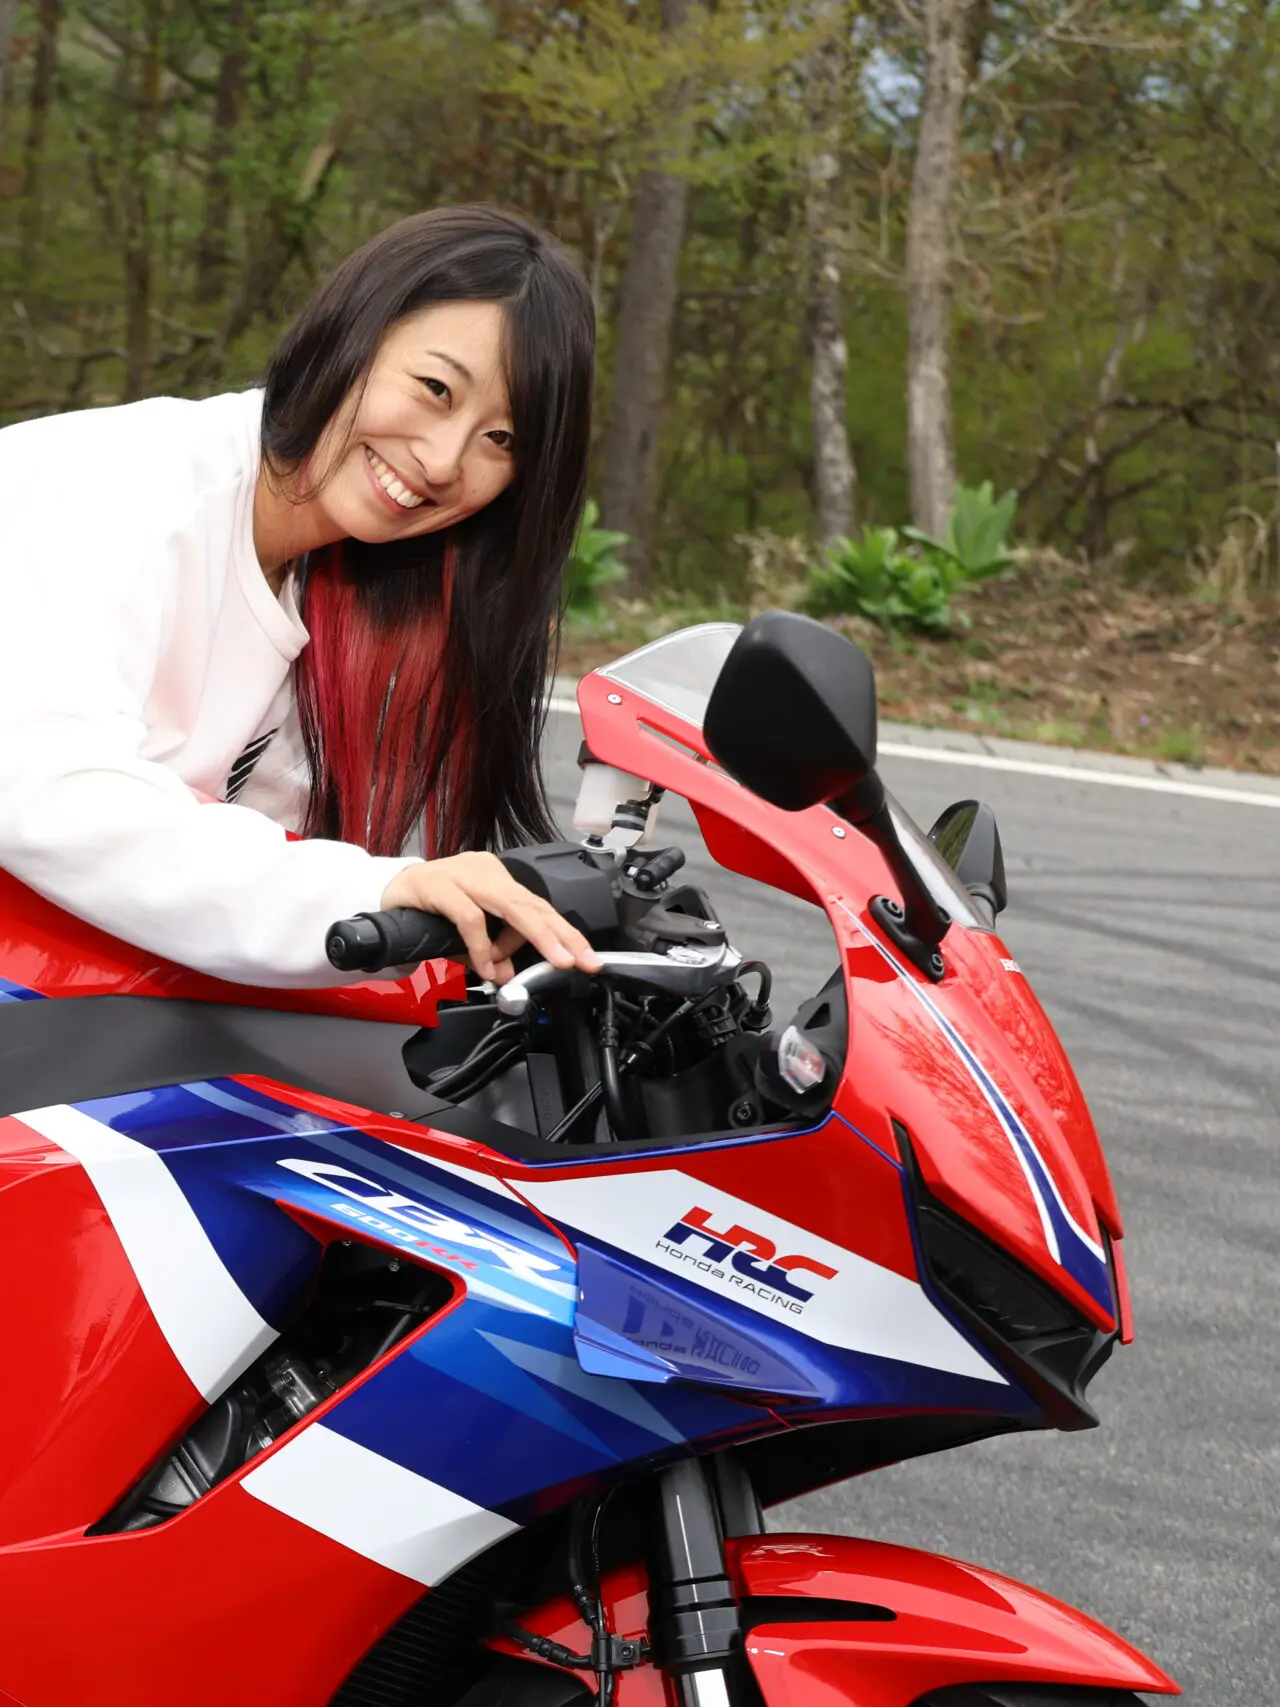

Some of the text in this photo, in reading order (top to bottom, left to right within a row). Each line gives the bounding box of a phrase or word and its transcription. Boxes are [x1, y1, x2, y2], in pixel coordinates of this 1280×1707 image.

[330, 1203, 479, 1273] 600RR
[663, 1206, 839, 1303] HRC
[655, 1240, 805, 1315] Honda RACING
